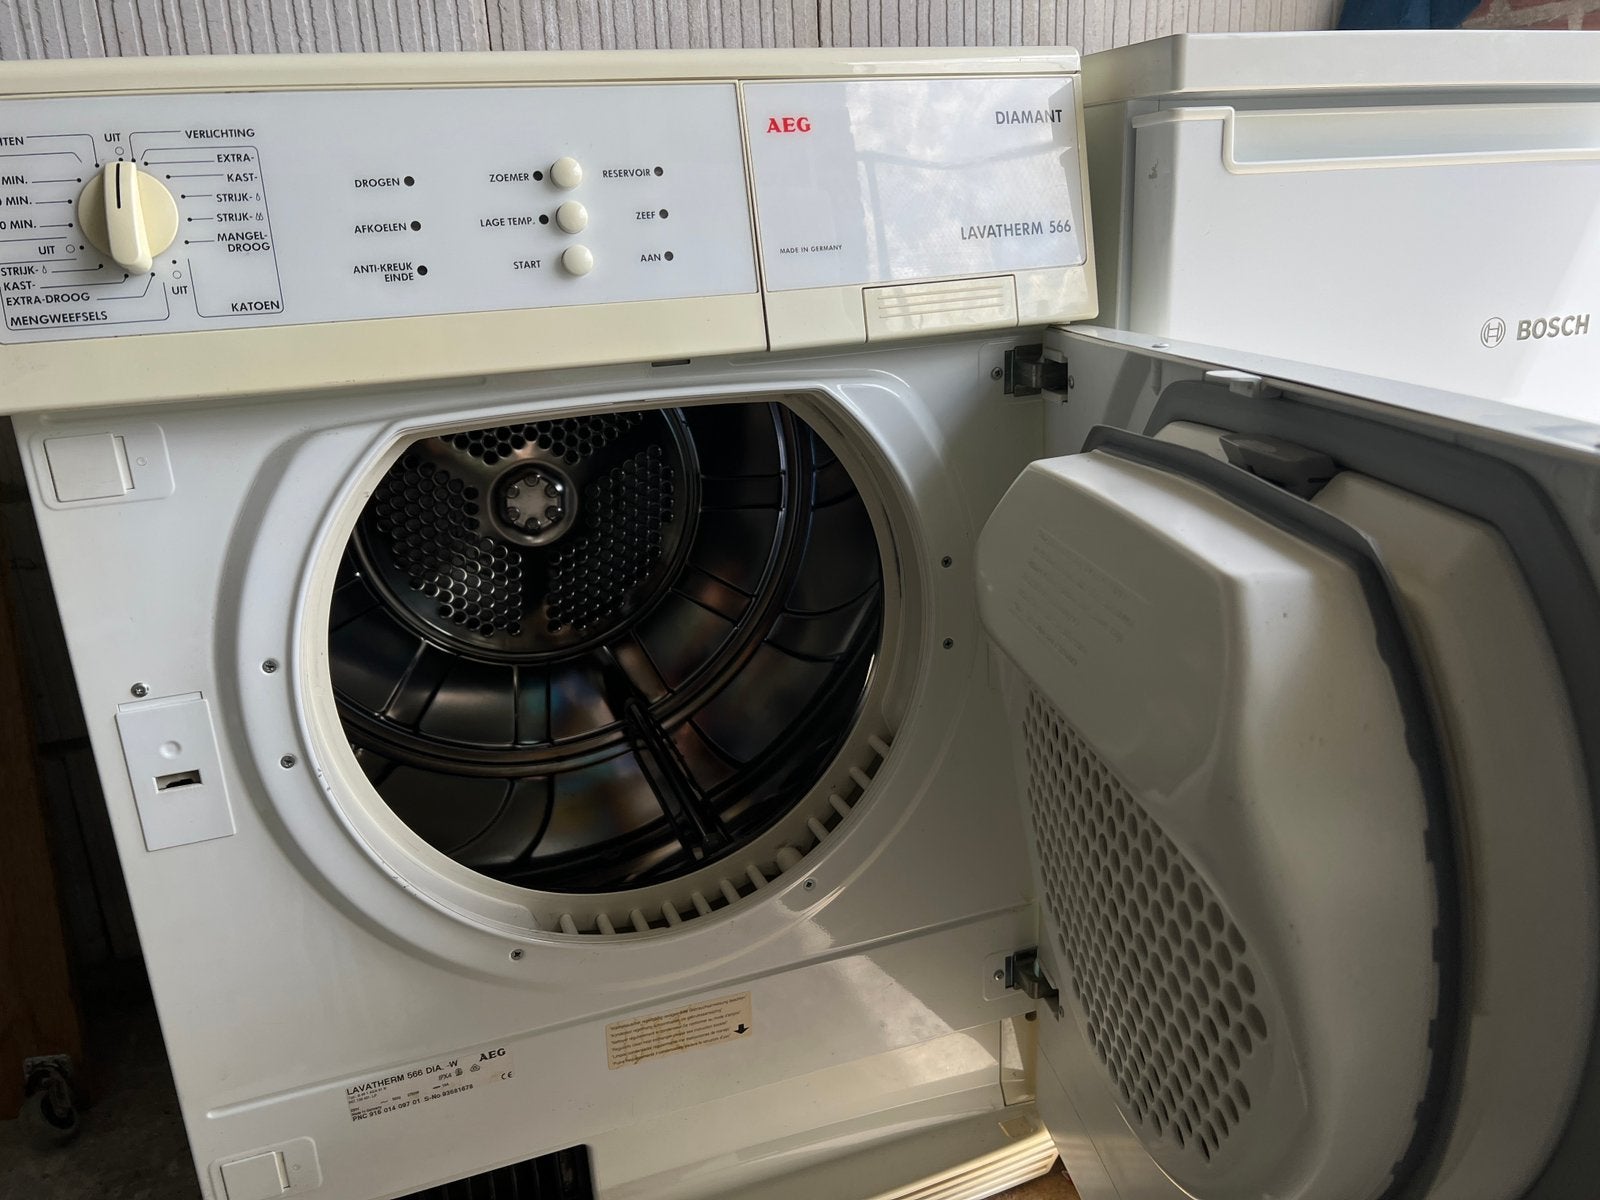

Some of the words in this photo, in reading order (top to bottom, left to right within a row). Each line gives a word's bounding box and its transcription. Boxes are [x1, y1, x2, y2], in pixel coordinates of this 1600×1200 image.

[995, 108, 1064, 128] DIAMANT
[766, 117, 811, 134] AEG
[104, 132, 121, 143] UIT
[184, 128, 255, 139] VERLICHTING
[216, 153, 255, 163] EXTRA-
[226, 172, 258, 182] KAST-
[489, 172, 530, 183] ZOEMER
[602, 168, 651, 178] RESERVOIR
[1, 175, 28, 186] MIN.
[354, 177, 400, 188] DROGEN
[5, 195, 32, 206] MIN.
[216, 192, 253, 203] STRIJK-
[216, 212, 253, 223] STRIJK-
[635, 211, 656, 220] ZEEF
[10, 219, 37, 230] MIN.
[480, 218, 506, 228] LAGE
[507, 216, 536, 226] TEMP.
[354, 222, 407, 234] AFKOELEN
[960, 221, 1044, 240] LAVATHERM
[1049, 219, 1072, 234] 566
[217, 231, 268, 242] MANGEL-
[38, 245, 55, 255] UIT
[227, 242, 271, 253] DROOG
[779, 247, 799, 255] MADE
[800, 246, 809, 254] IN
[810, 244, 842, 253] GERMANY
[640, 253, 661, 262] AAN
[353, 262, 413, 274] ANTI-KREUK
[513, 259, 541, 270] START
[0, 265, 39, 277] STRIJK-
[384, 272, 414, 283] EINDE
[3, 280, 36, 291] KAST-
[171, 285, 188, 295] UIT
[6, 292, 90, 306] EXTRA-DROOG
[231, 300, 281, 312] KATOEN
[10, 310, 108, 326] MENGWEEFSELS
[1516, 313, 1590, 341] BOSCH
[478, 1047, 507, 1062] AEG
[346, 1074, 405, 1096] LAVATHERM
[406, 1069, 424, 1080] 566
[352, 1113, 368, 1122] PNC
[384, 1105, 396, 1113] 014
[398, 1101, 410, 1109] 097
